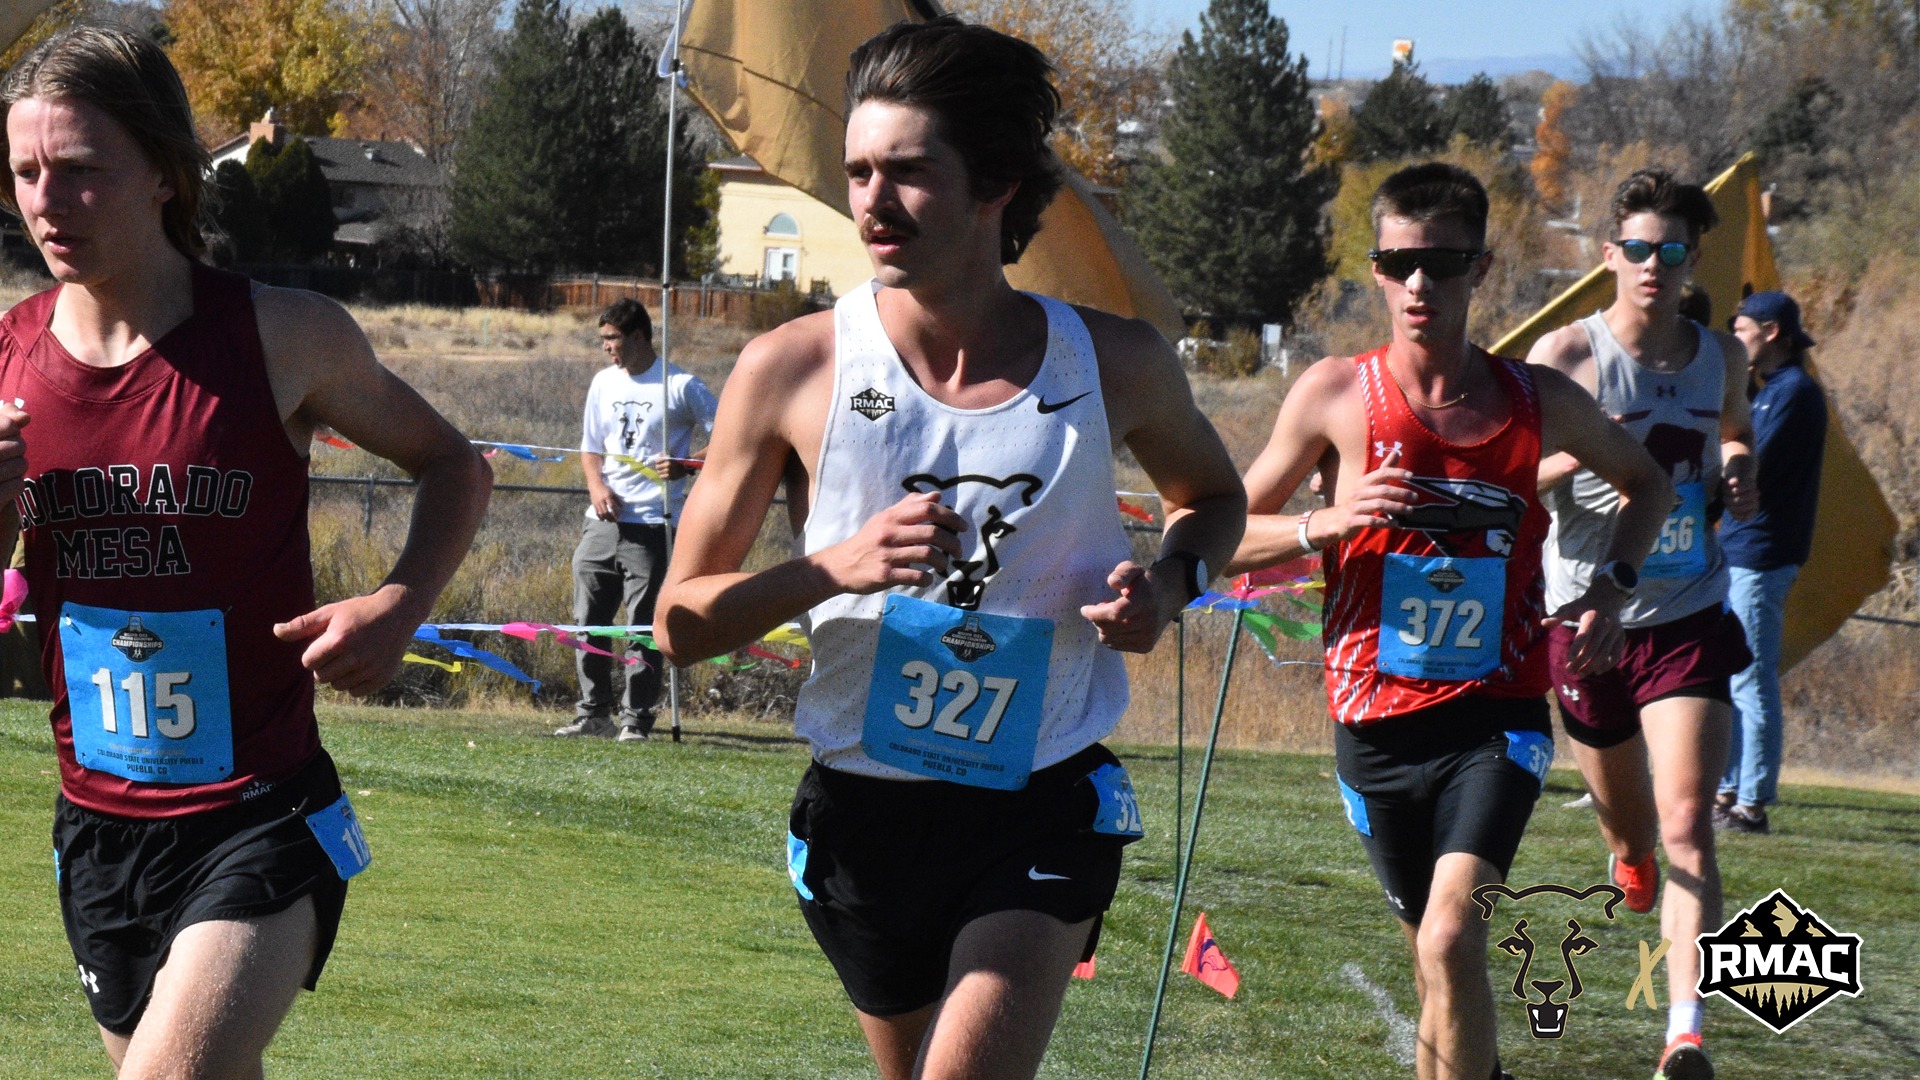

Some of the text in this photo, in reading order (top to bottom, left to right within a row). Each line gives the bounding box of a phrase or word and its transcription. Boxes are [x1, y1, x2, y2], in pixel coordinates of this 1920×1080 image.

[853, 398, 893, 409] RMAC
[52, 525, 191, 579] MESA
[1398, 597, 1485, 648] 372
[112, 638, 163, 649] CHAMPIONSHIPS
[942, 635, 996, 652] CHAMPIONSHIPS
[92, 667, 196, 740] 115
[894, 660, 1019, 744] 327
[97, 748, 123, 760] COLORADO
[124, 754, 140, 764] STATE
[889, 742, 921, 757] COLORADO
[923, 750, 940, 761] STATE
[127, 763, 168, 776] PUEBLO, CO
[923, 759, 967, 777] PUEBLO, CO
[1529, 744, 1550, 785] 37
[1114, 790, 1141, 832] 32
